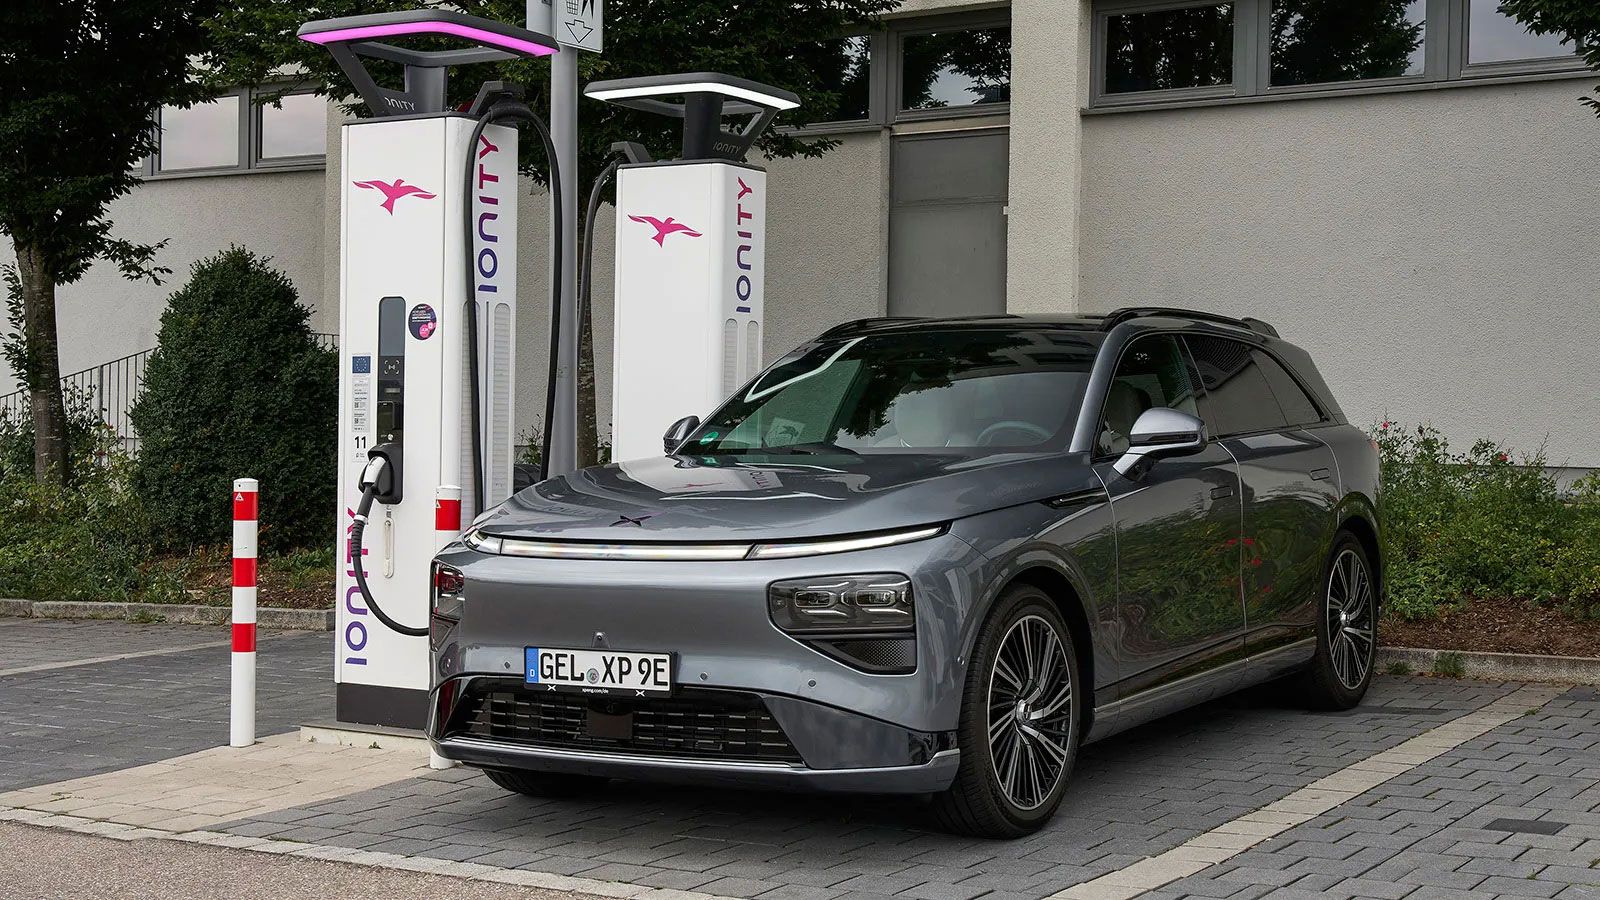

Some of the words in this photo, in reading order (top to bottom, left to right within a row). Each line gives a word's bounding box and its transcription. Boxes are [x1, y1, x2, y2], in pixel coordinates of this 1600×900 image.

[478, 134, 499, 293] IONITY
[736, 176, 752, 313] IONITY
[354, 436, 366, 449] 11
[540, 652, 584, 681] GEL
[602, 656, 632, 684] XP
[638, 657, 669, 686] 9E
